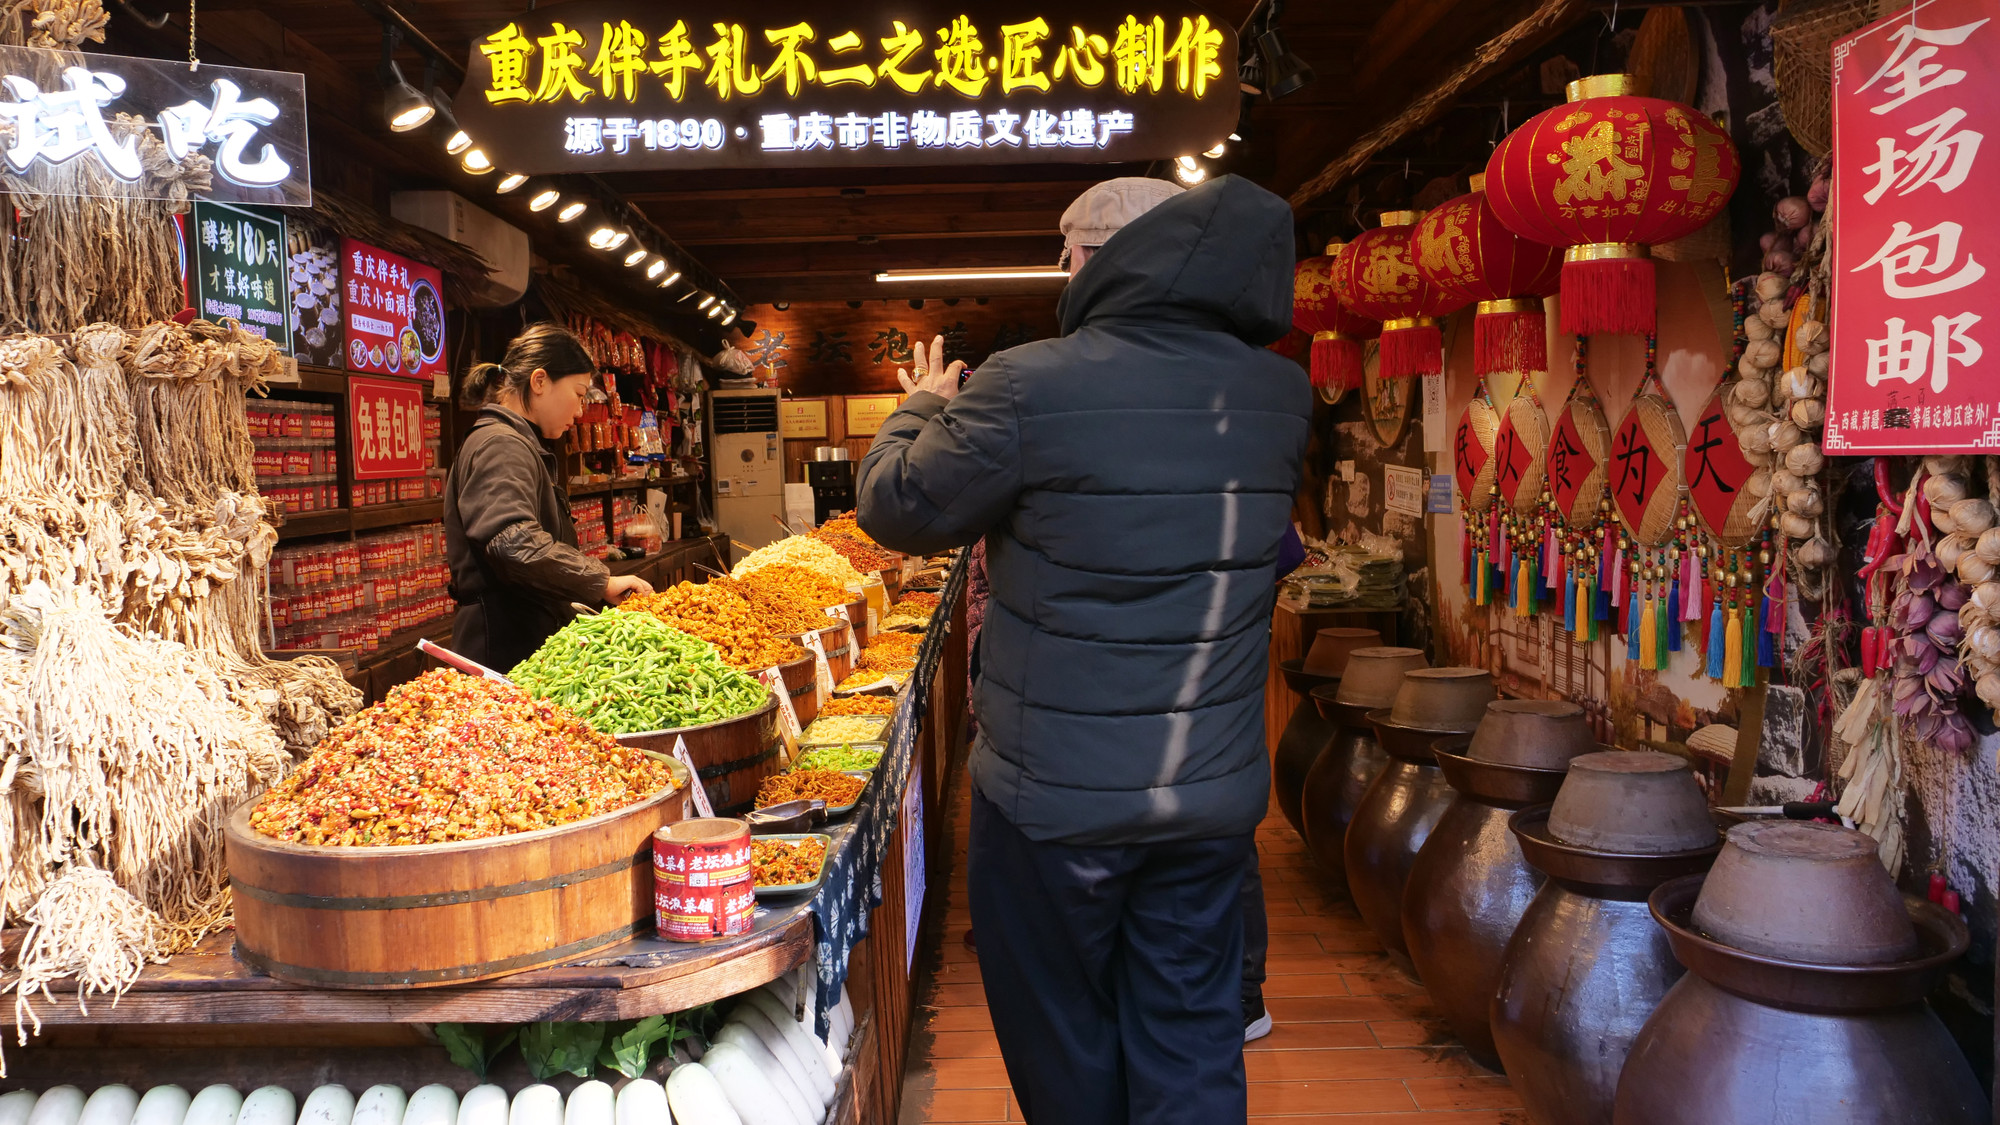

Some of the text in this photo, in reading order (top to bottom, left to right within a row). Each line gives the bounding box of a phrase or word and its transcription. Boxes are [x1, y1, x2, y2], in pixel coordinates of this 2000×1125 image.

[479, 15, 1224, 104] 重庆伴手礼不二之选·匠心制作
[0, 66, 292, 188] 试吃
[1559, 202, 1642, 219] 万事如意
[1851, 16, 1991, 393] 全场包邮
[208, 264, 277, 306] 才算好味道
[347, 278, 418, 320] 重庆小面调料
[352, 250, 411, 290] 重庆伴手礼
[357, 395, 422, 462] 免费包邮
[1456, 412, 1734, 505] 民 以 食 为 天
